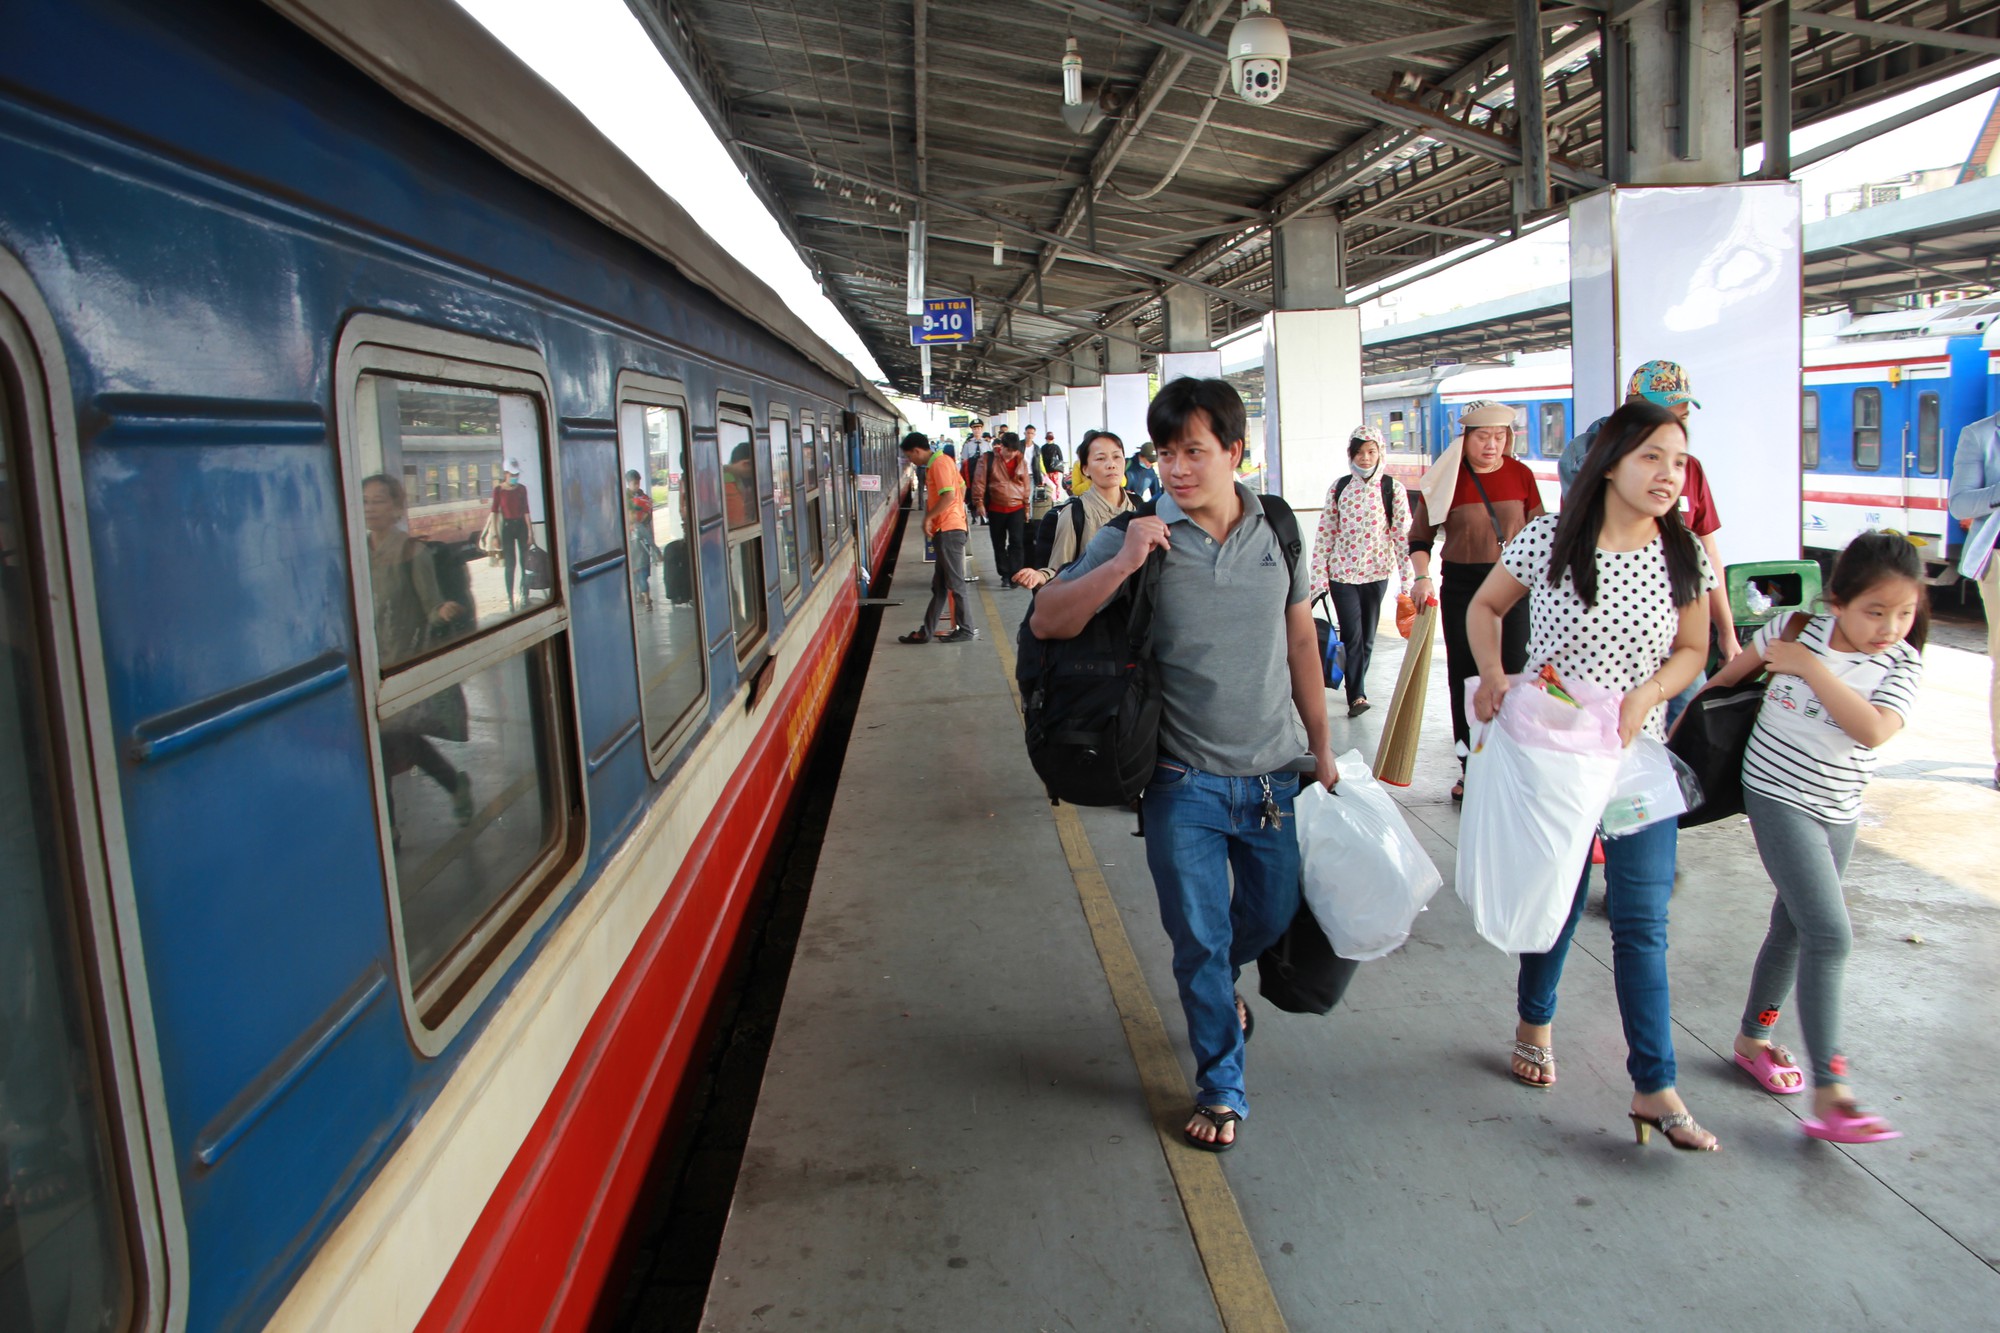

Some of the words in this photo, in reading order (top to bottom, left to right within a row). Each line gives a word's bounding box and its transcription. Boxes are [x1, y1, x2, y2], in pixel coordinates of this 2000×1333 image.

[947, 301, 967, 310] TOA
[922, 313, 962, 332] 9-10
[1865, 512, 1880, 524] VNR
